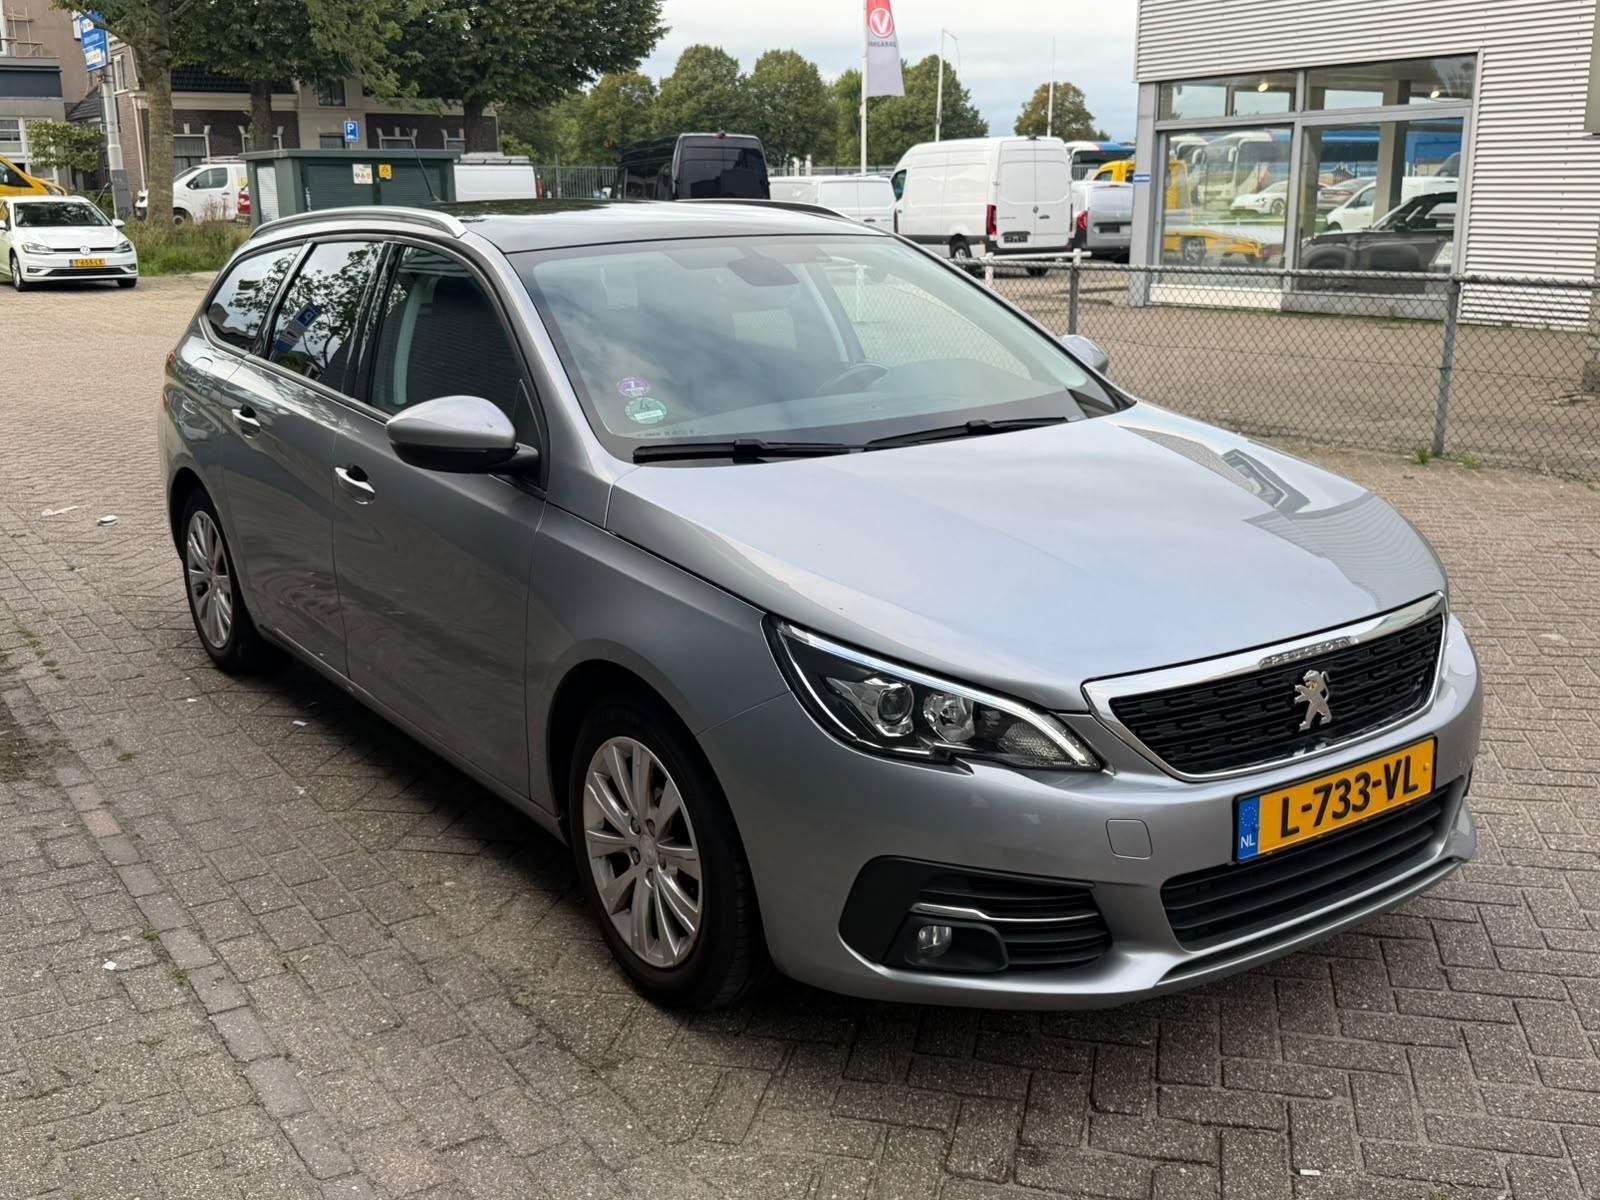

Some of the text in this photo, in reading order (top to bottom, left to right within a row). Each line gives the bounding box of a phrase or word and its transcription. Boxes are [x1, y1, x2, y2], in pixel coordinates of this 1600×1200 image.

[347, 123, 354, 133] P
[1271, 638, 1346, 665] PEUGEOT
[1280, 755, 1418, 838] L-733-VL
[1240, 834, 1256, 848] NL
